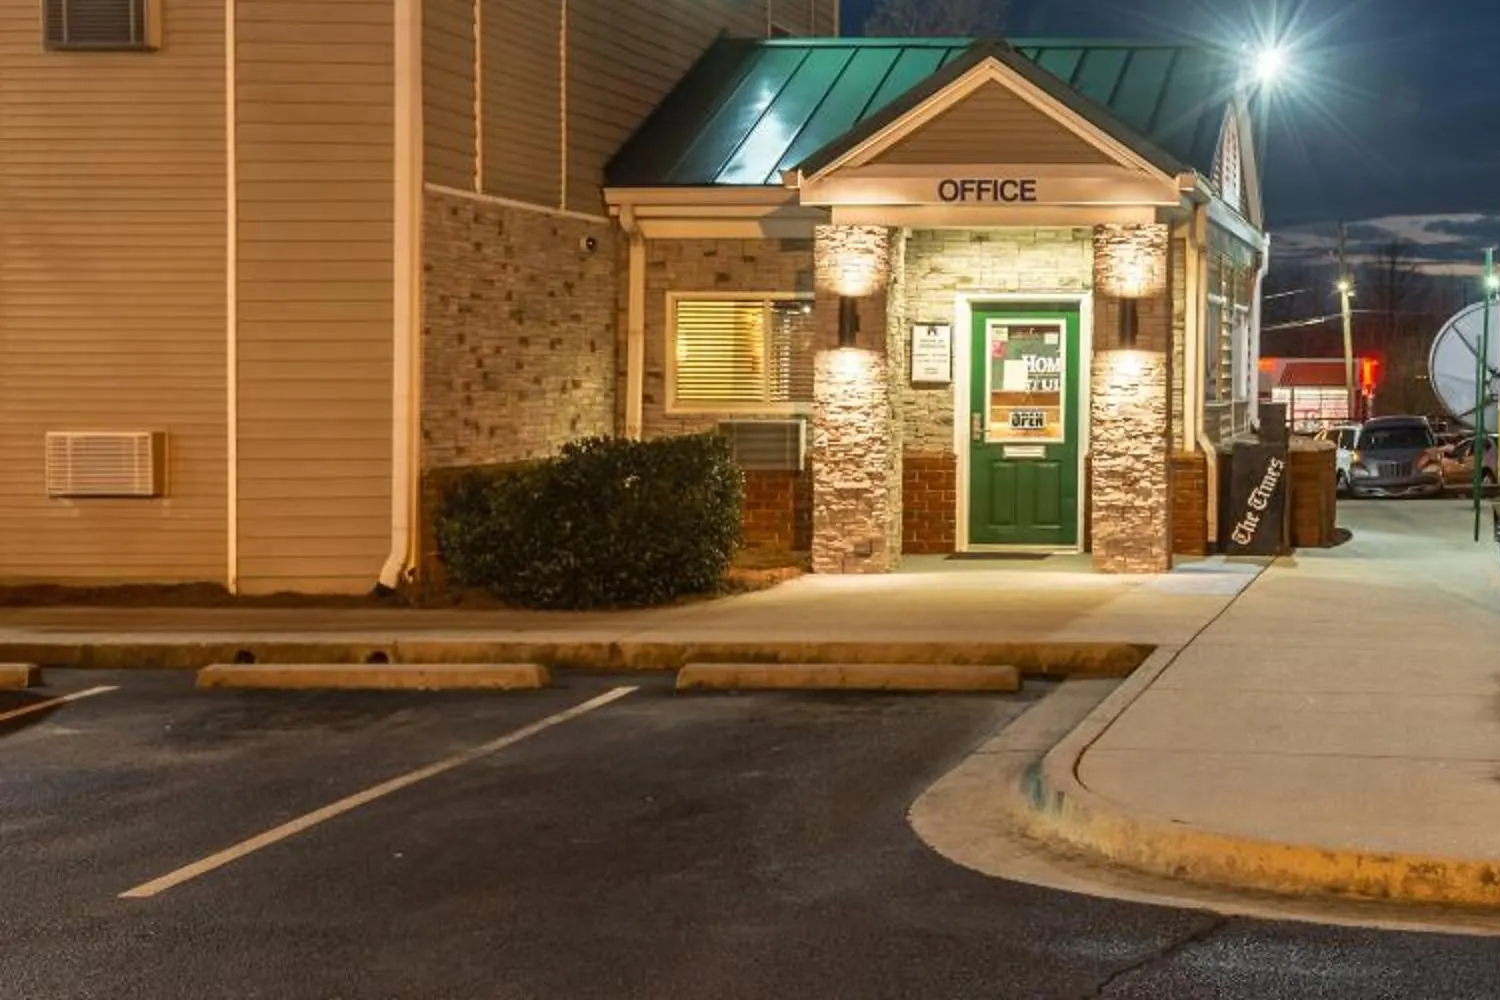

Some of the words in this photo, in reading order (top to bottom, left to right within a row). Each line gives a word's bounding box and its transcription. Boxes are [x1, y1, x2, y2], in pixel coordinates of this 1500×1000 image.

[938, 179, 1037, 202] OFFICE
[1012, 413, 1044, 428] OPEN
[1231, 511, 1260, 545] The
[1247, 457, 1285, 511] Times
